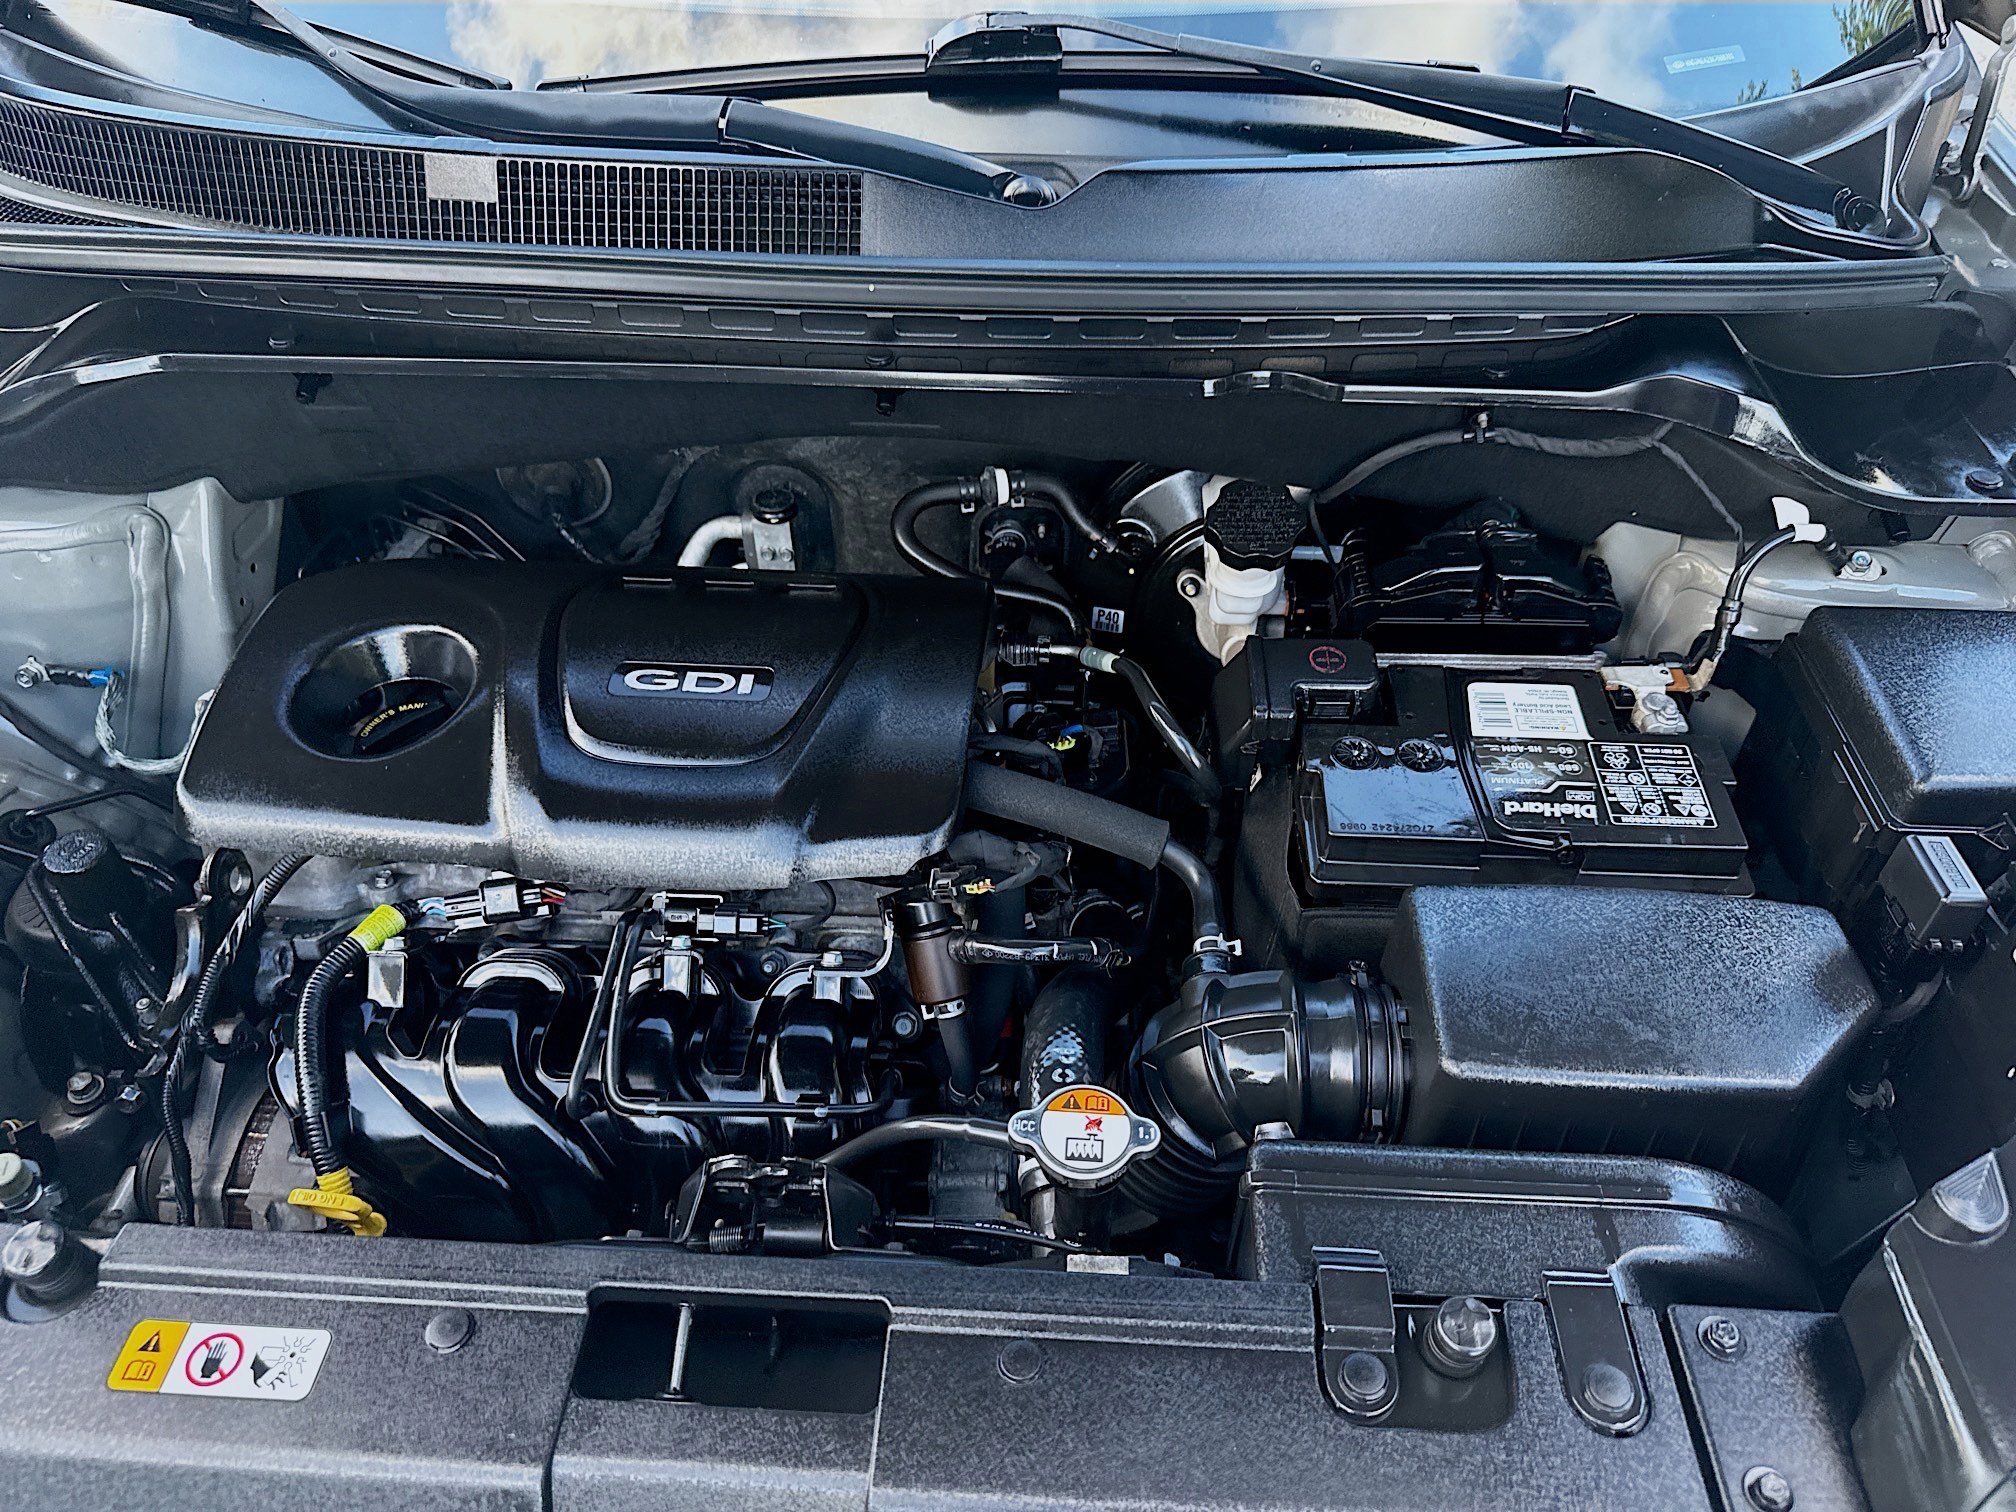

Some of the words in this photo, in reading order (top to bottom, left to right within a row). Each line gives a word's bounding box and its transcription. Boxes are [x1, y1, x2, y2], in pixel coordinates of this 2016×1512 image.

[1097, 609, 1120, 623] P40
[623, 669, 754, 695] GDI
[398, 702, 428, 712] MAN
[1490, 776, 1545, 785] PLATINUM
[1504, 801, 1597, 819] DieHard
[1013, 1119, 1036, 1132] HCC
[1138, 1126, 1155, 1140] 1.1
